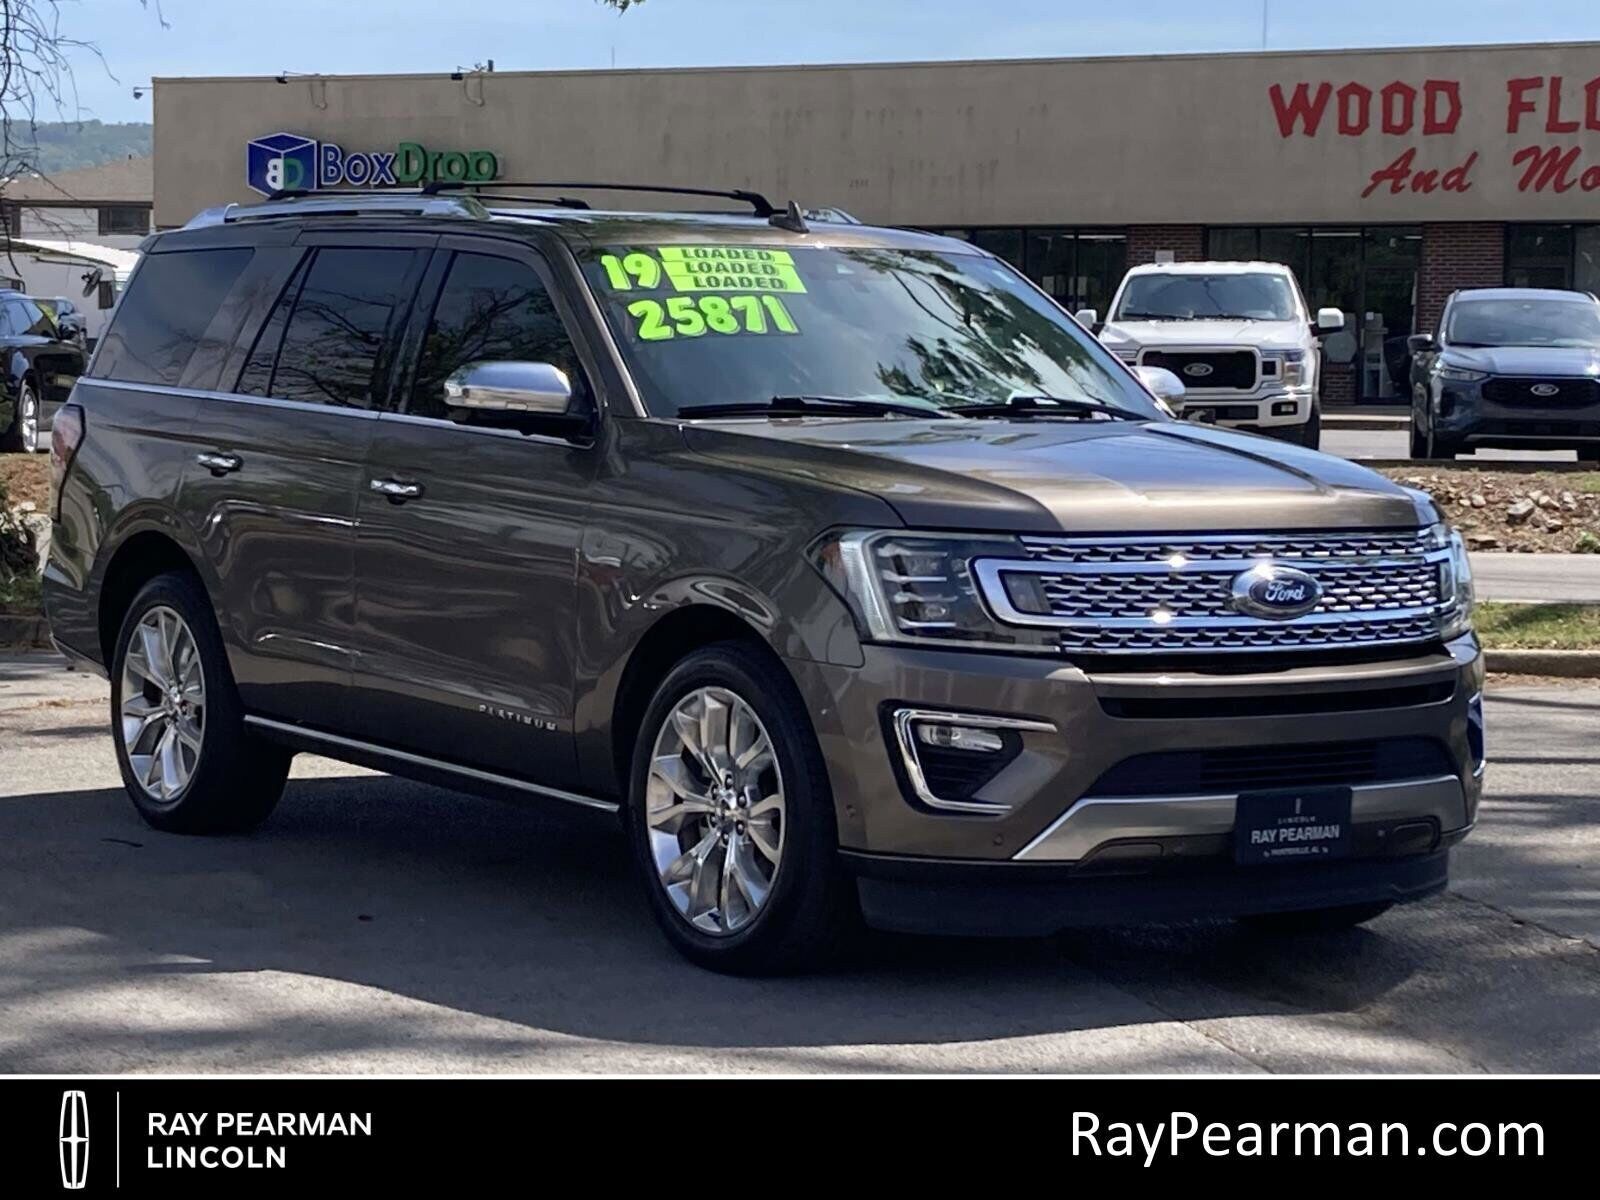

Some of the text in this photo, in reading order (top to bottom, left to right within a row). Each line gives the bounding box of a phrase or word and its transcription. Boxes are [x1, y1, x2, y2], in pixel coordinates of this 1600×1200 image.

[1268, 79, 1463, 138] WOOD
[320, 141, 499, 185] BoxDrop
[1361, 147, 1479, 198] And
[681, 248, 775, 262] LOADED
[601, 253, 661, 291] 19
[686, 261, 780, 276] LOADED
[693, 275, 788, 290] LOADED
[627, 295, 799, 339] 25871
[1265, 579, 1305, 602] Ford
[478, 704, 556, 730] PLATINUM
[1251, 824, 1340, 844] RAY PEARMAN
